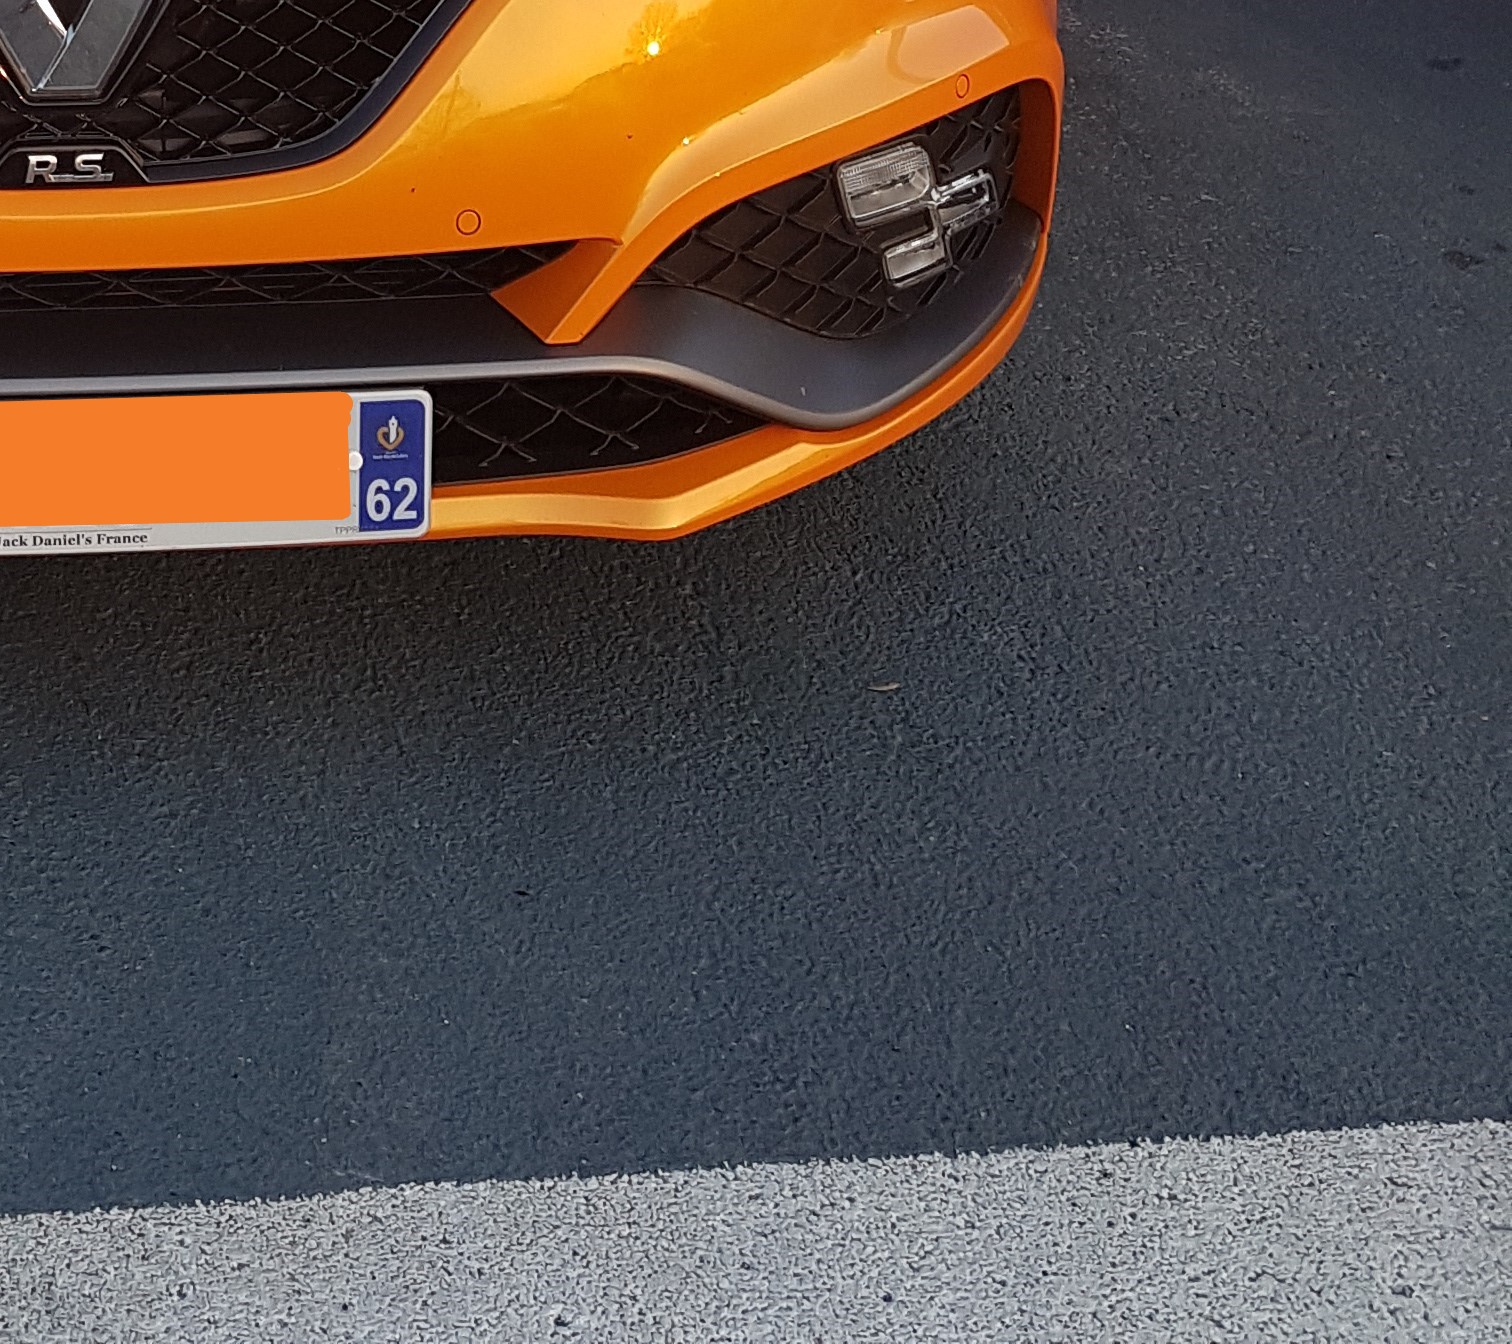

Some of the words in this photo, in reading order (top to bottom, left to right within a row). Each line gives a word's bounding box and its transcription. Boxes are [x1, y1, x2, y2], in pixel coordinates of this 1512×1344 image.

[366, 477, 418, 522] 62
[32, 533, 93, 547] Daniel's
[96, 533, 148, 545] France
